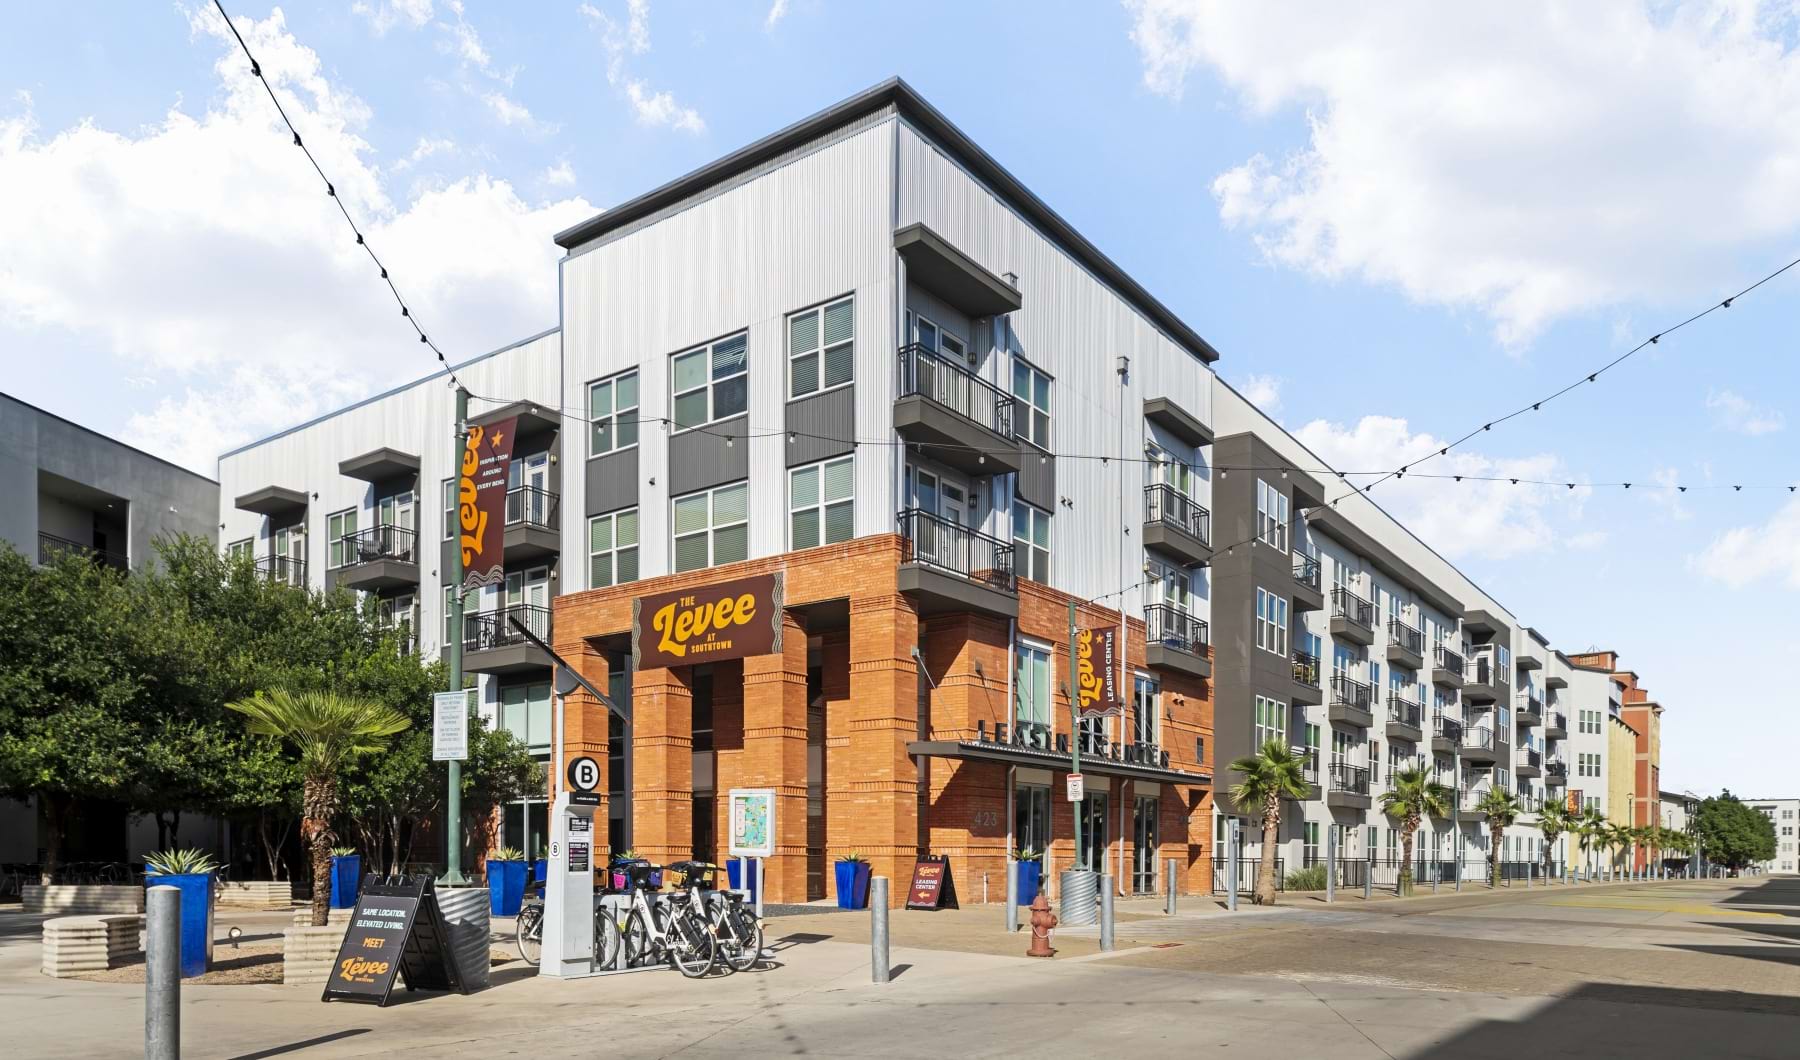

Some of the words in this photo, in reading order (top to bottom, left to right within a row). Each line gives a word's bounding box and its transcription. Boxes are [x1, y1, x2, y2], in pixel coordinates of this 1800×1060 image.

[480, 454, 508, 465] INSPIRTION
[482, 467, 502, 477] AROUND
[476, 481, 491, 490] EVERY
[460, 425, 487, 566] Levee
[680, 596, 695, 607] THE
[653, 593, 756, 657] Levee
[707, 633, 716, 642] AT
[691, 640, 732, 653] SOUTHTOWN
[1105, 631, 1113, 665] CENTER
[1080, 628, 1103, 707] Levee
[1105, 666, 1114, 702] LEASING
[581, 765, 593, 784] B
[975, 811, 997, 826] 423
[362, 908, 378, 916] SAME
[356, 919, 384, 928] ELEVATED
[363, 938, 385, 948] MEET
[340, 958, 389, 981] Levee
